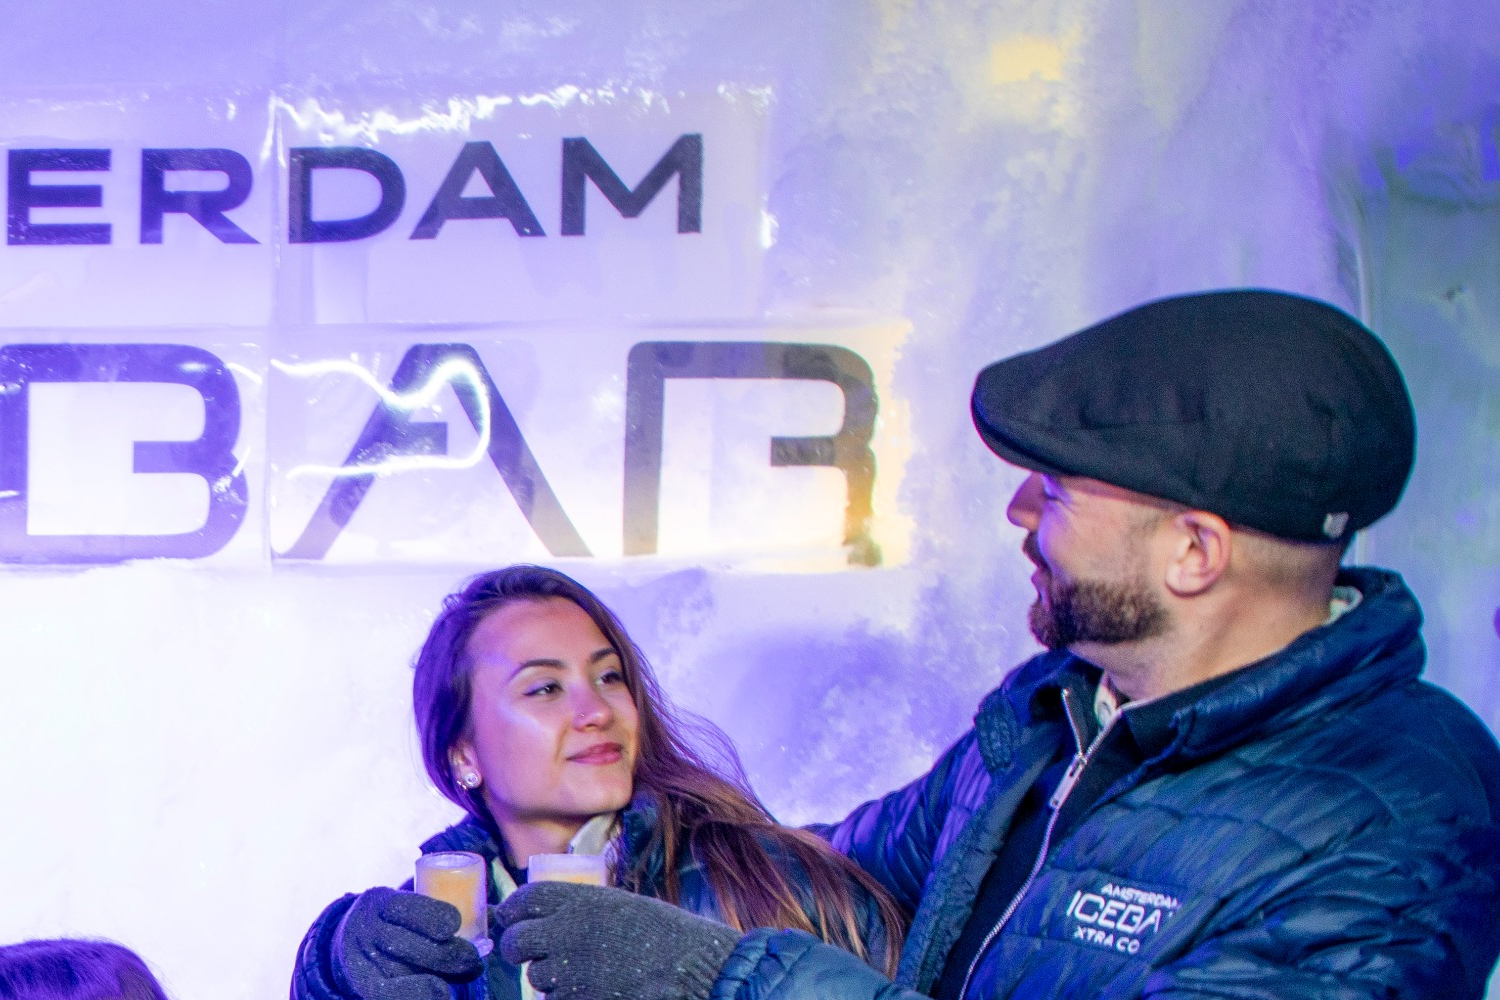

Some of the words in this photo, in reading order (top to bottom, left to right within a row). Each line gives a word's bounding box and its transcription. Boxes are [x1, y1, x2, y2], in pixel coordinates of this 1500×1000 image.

[1066, 889, 1173, 934] ICEBA
[1074, 926, 1114, 948] XTRA
[1115, 937, 1141, 955] CO
